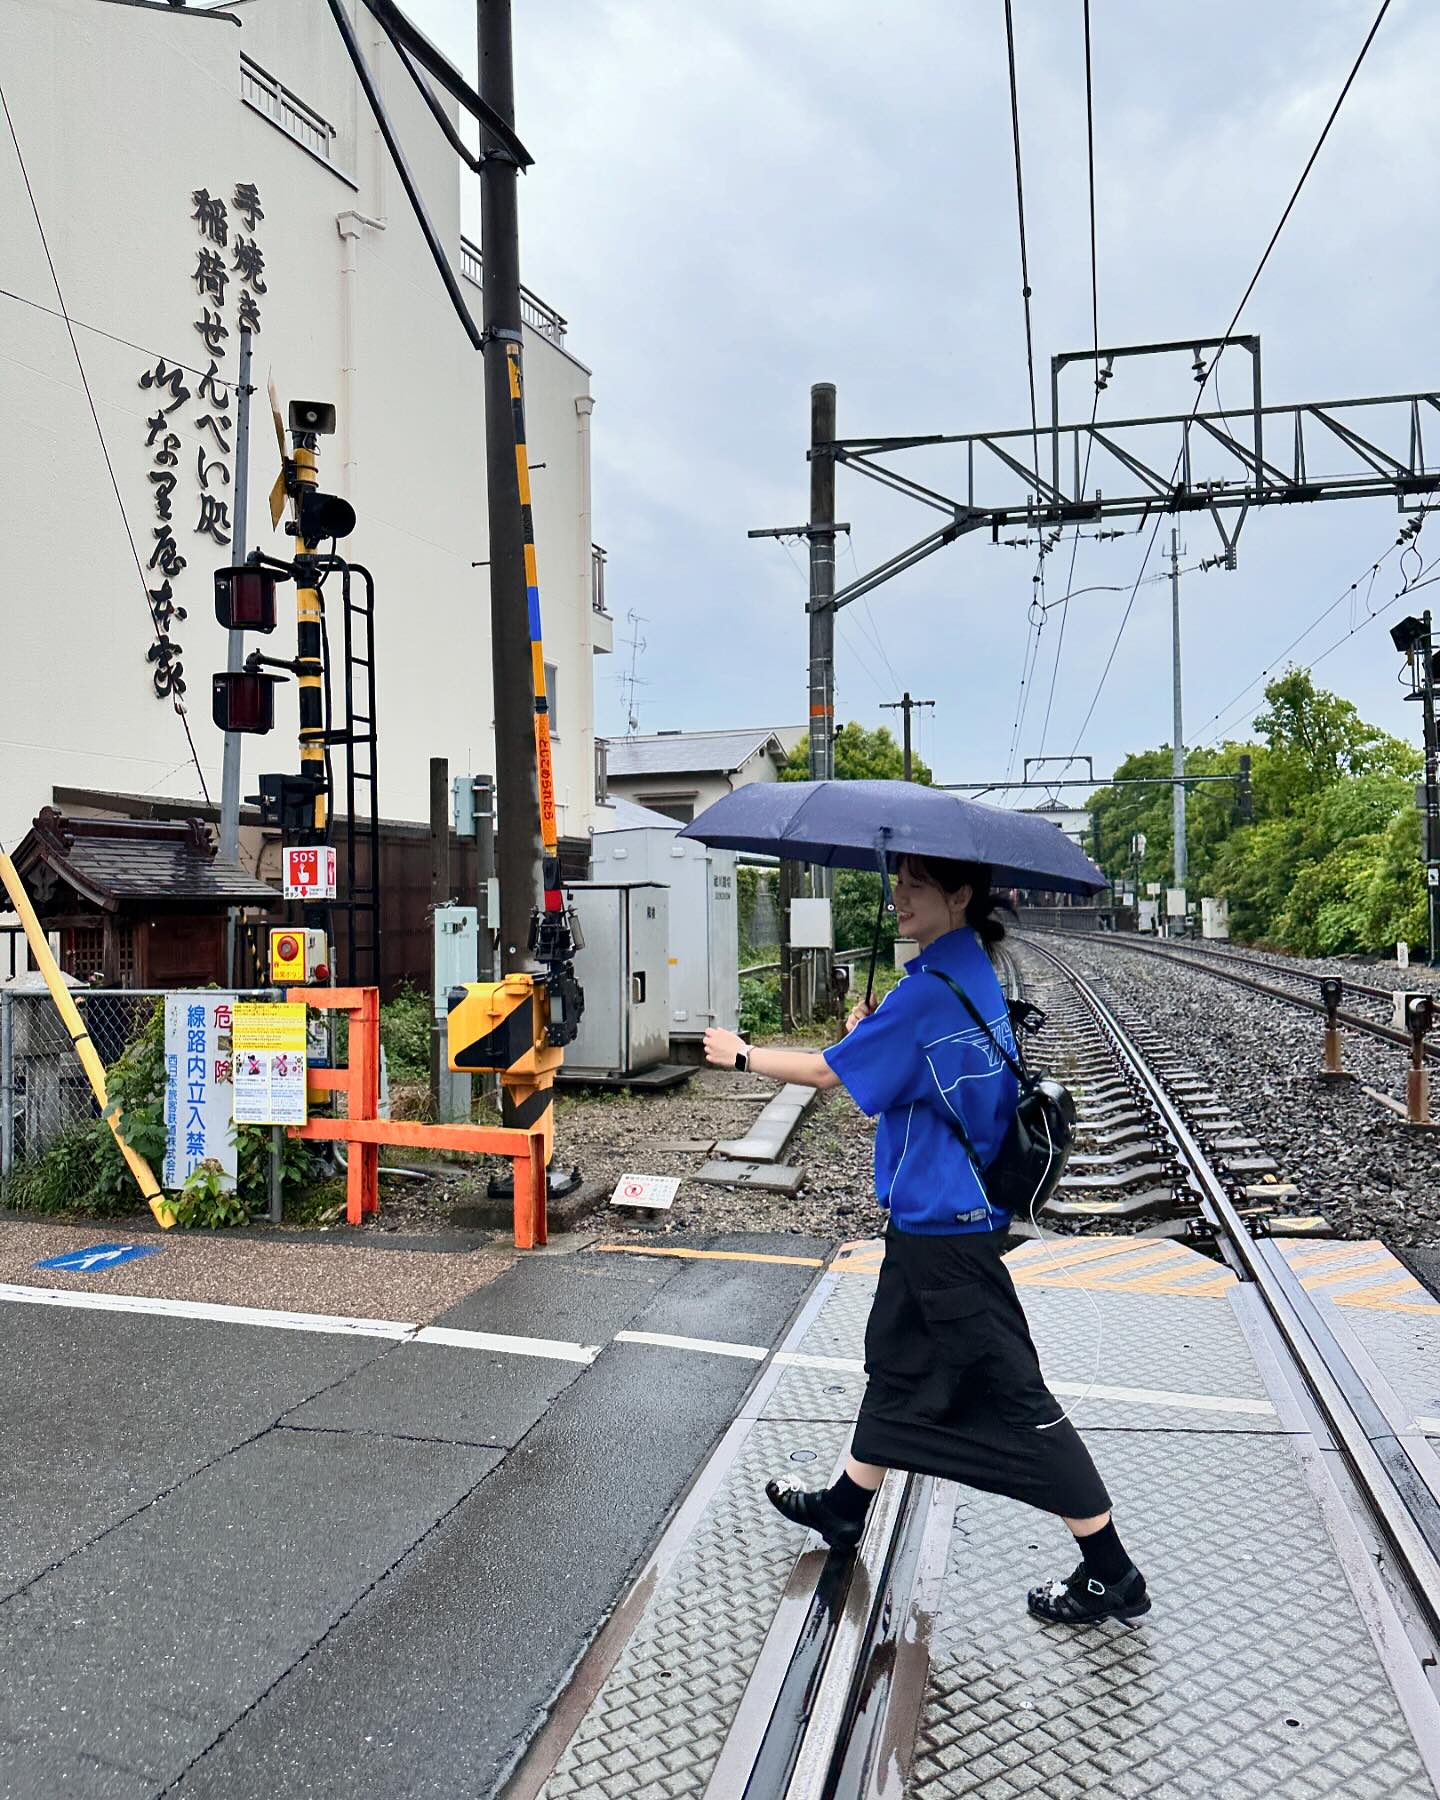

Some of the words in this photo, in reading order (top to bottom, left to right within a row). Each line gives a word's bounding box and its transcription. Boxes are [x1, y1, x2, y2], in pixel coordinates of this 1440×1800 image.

[231, 183, 267, 334] 手焼き
[191, 188, 232, 546] 稲荷せんべい処
[292, 852, 315, 863] SOS
